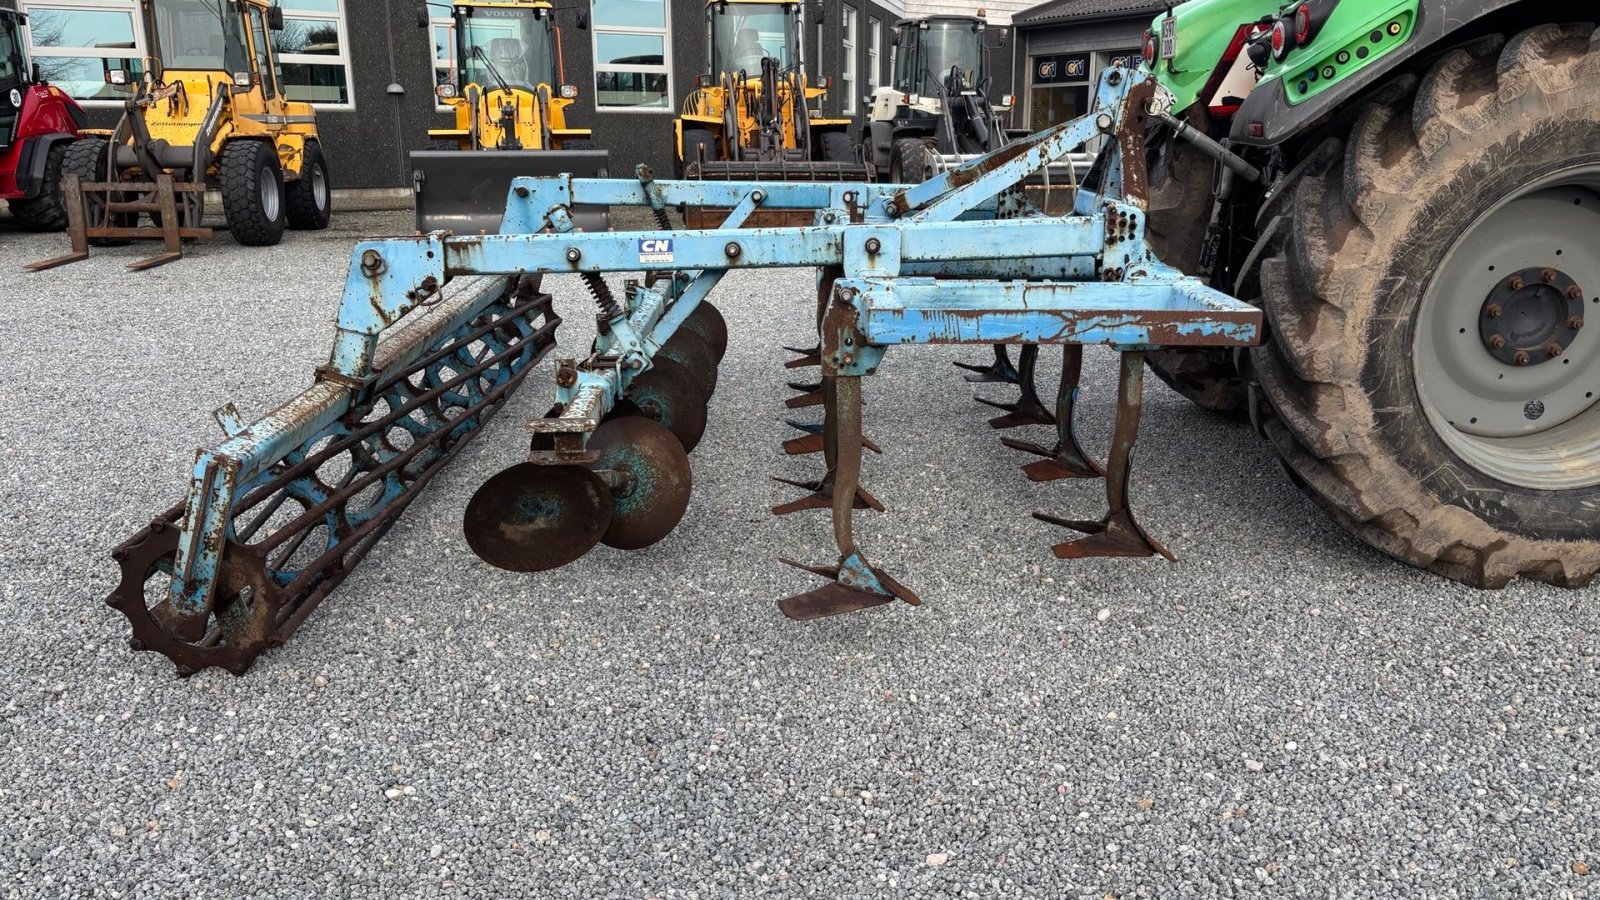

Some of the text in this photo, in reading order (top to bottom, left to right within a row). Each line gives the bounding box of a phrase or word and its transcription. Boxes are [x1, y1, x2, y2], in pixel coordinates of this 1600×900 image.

[1065, 60, 1085, 76] CN
[11, 92, 20, 104] 30
[641, 240, 669, 252] CN
